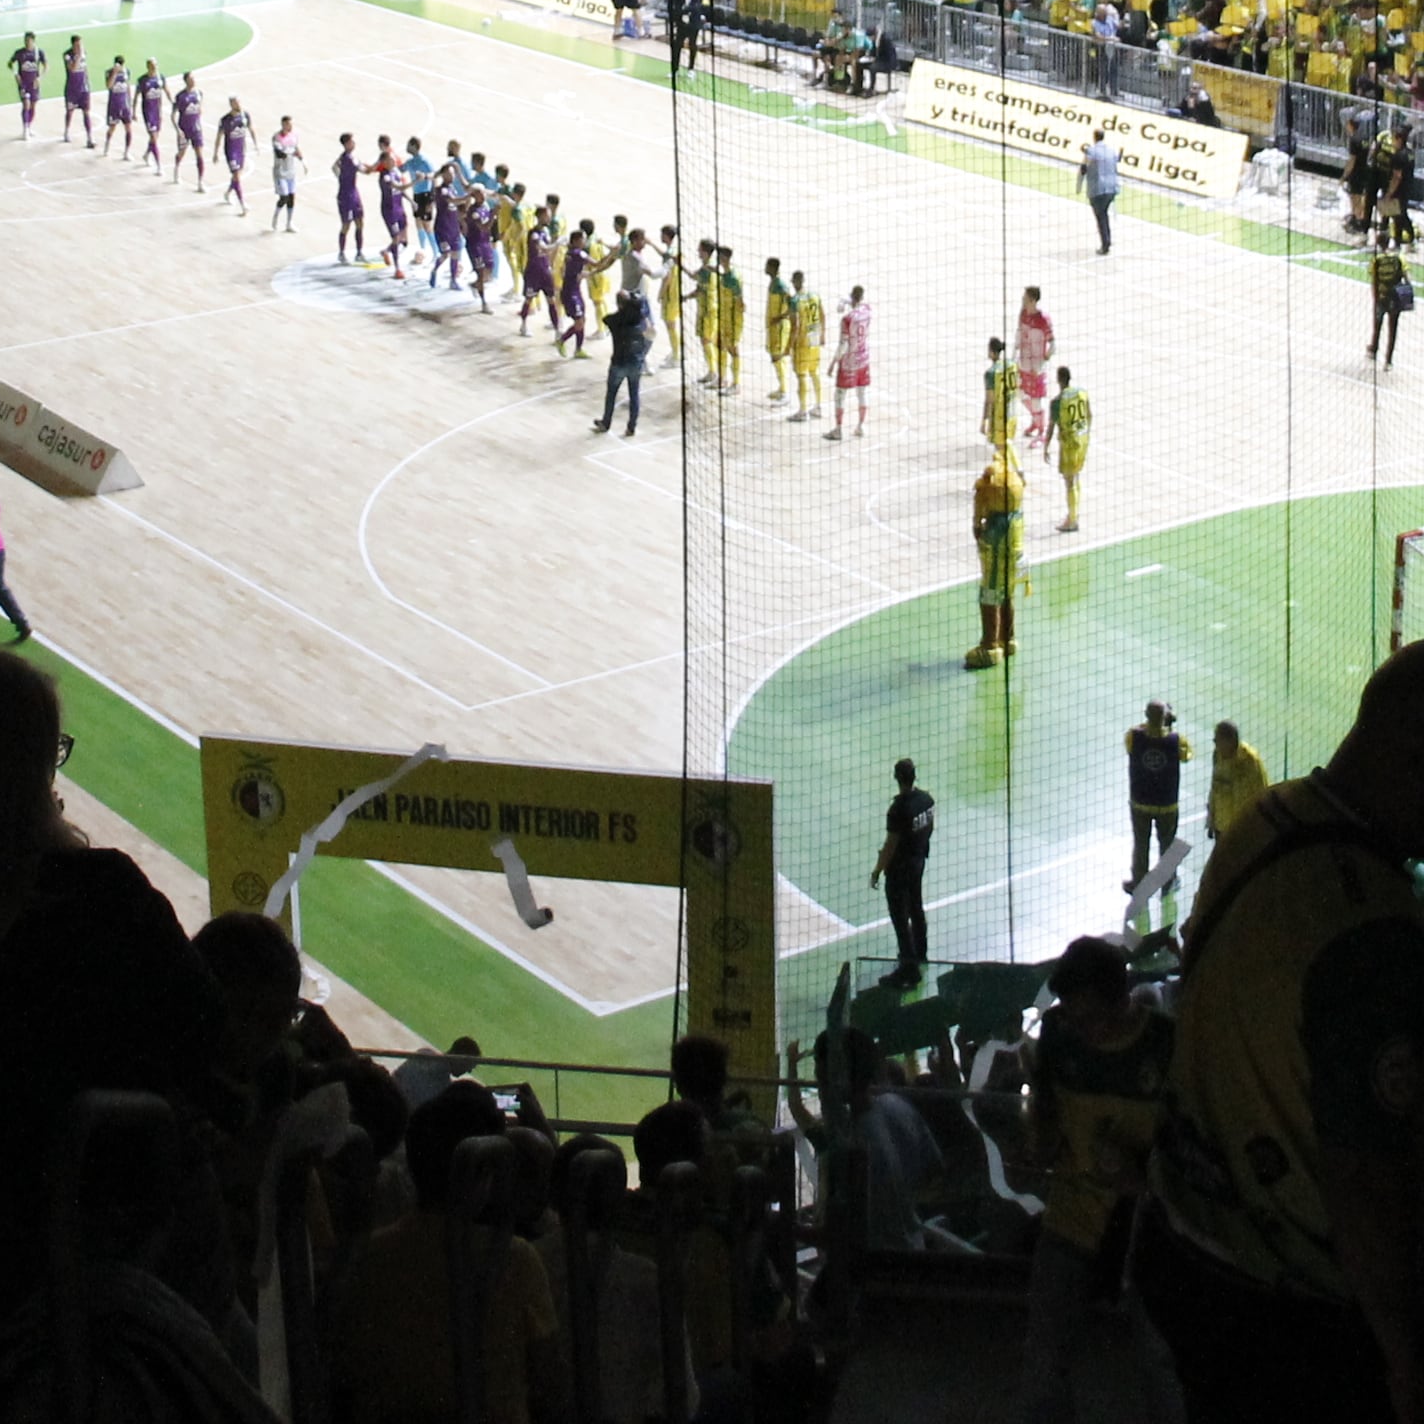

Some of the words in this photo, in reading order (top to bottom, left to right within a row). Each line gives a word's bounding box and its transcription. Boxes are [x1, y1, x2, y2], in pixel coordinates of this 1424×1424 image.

[934, 75, 977, 97] eres
[984, 88, 1092, 126] campeón
[1101, 115, 1132, 134] de
[1140, 123, 1216, 158] Copa,
[931, 103, 943, 119] y
[951, 106, 1072, 149] triunfador
[1118, 147, 1139, 168] la
[1148, 153, 1208, 186] liga,
[1067, 398, 1086, 426] 20
[37, 424, 92, 467] cajasur
[394, 792, 493, 831] PARAÍSO
[498, 802, 600, 841] INTERIOR
[607, 812, 640, 843] FS
